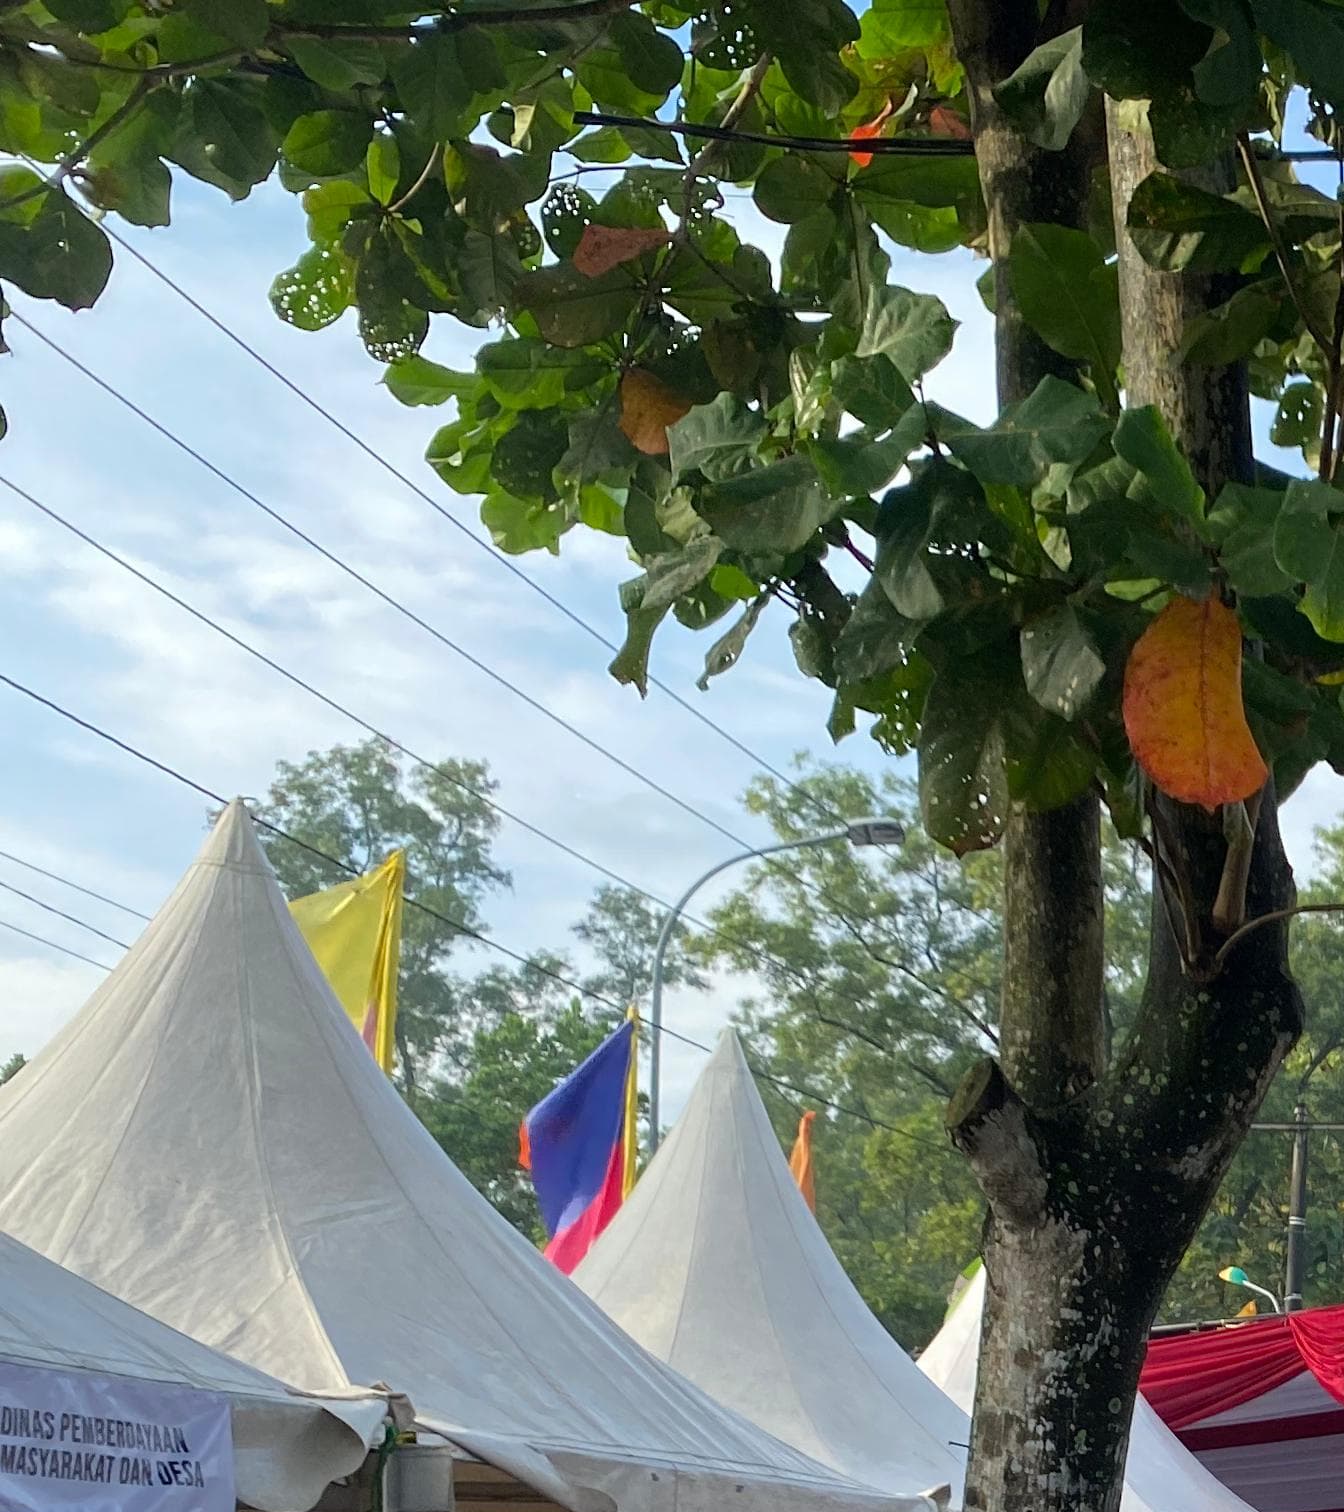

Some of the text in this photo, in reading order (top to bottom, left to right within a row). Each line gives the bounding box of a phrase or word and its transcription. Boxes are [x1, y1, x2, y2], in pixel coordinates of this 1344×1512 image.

[1, 1405, 190, 1454] DINAS PEMBERDAYAAN
[0, 1443, 205, 1488] MASYARAKAT DAN DESA
